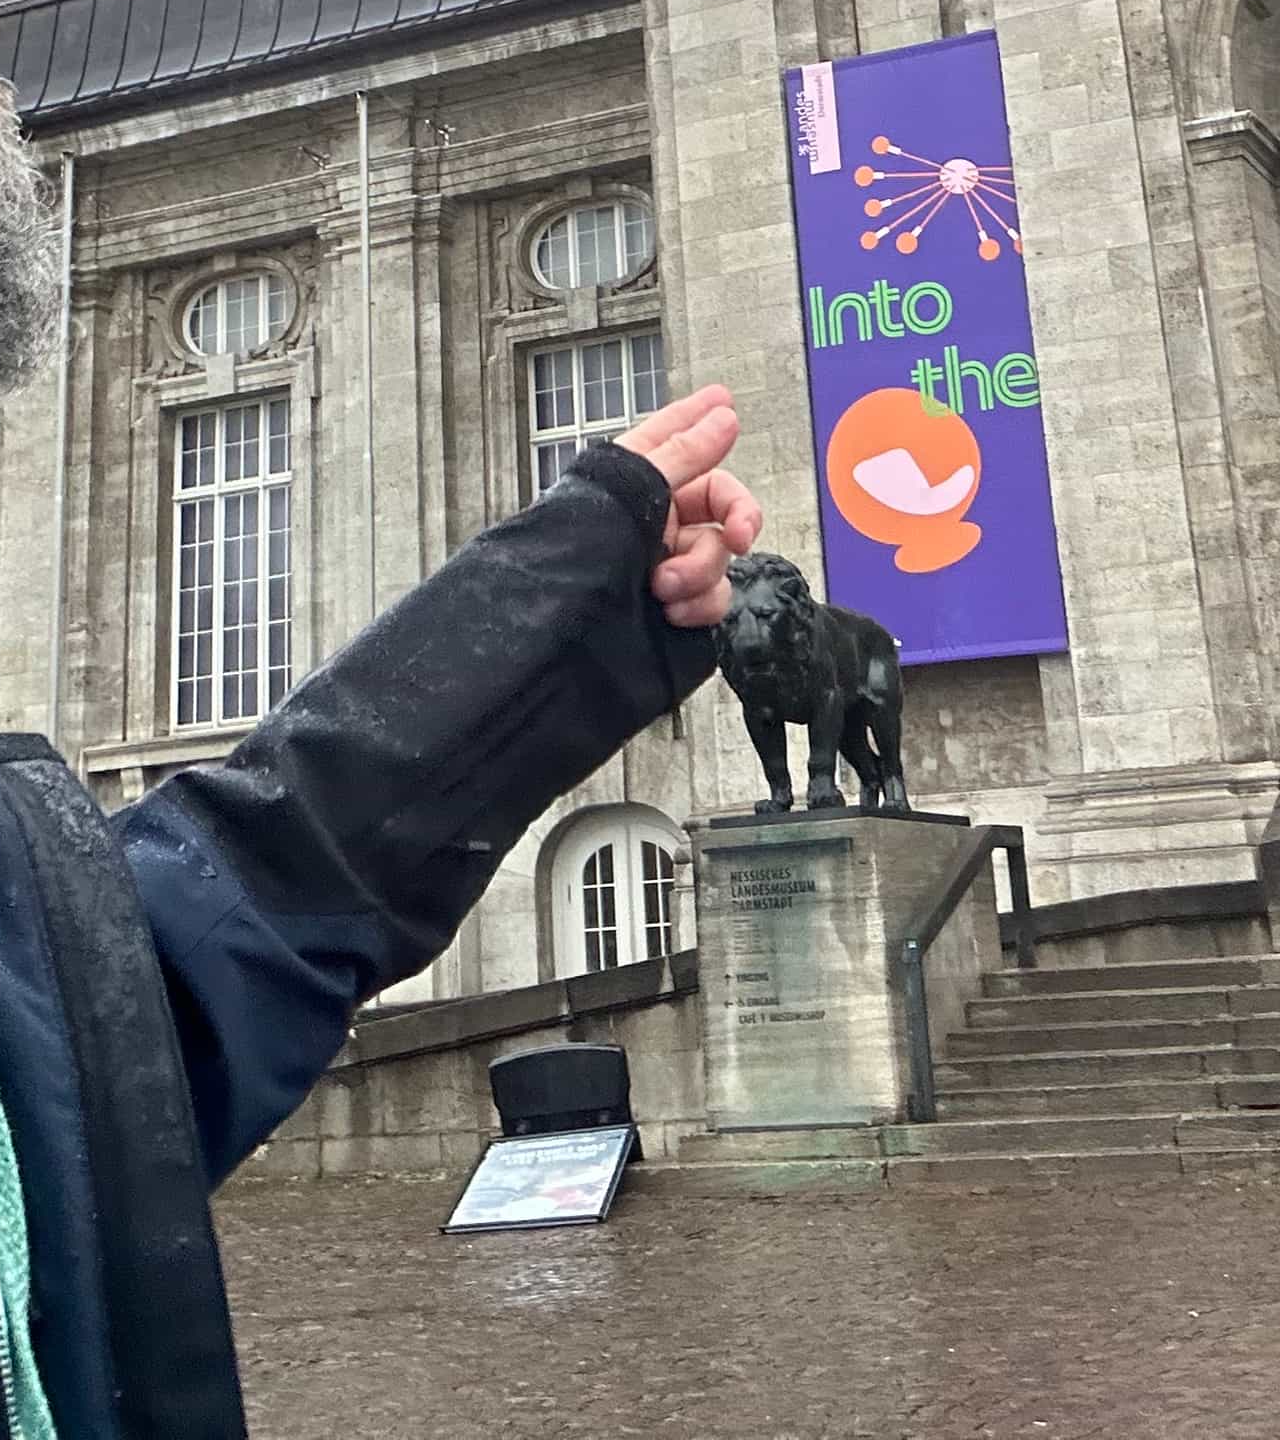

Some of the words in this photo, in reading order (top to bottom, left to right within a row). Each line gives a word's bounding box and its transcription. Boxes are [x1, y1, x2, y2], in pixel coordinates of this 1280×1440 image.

[794, 90, 810, 142] Landes
[809, 279, 953, 348] Into
[911, 345, 1041, 417] the
